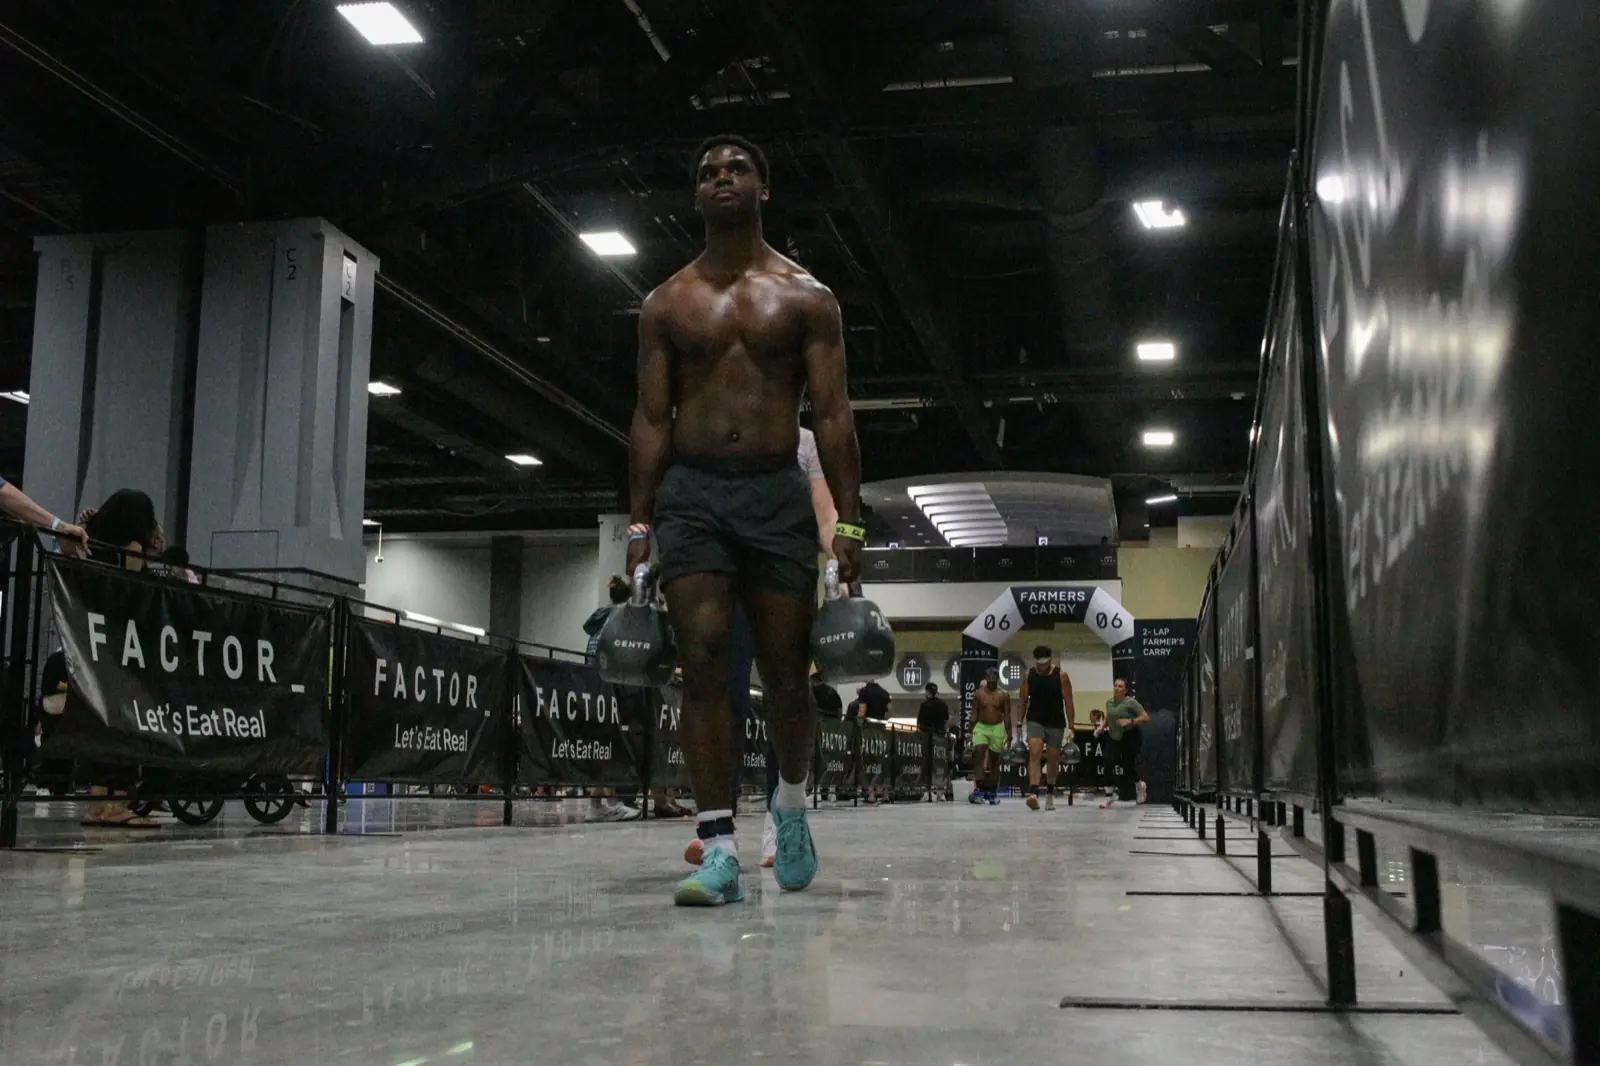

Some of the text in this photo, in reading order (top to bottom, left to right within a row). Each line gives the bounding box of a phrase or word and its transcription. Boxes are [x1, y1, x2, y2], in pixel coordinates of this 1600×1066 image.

[287, 265, 297, 280] 2
[1020, 591, 1086, 602] FARMERS
[1030, 604, 1076, 615] CARRY
[984, 614, 1010, 631] 06
[1096, 612, 1123, 629] 06
[820, 632, 856, 644] CENTR
[1143, 638, 1185, 646] FARMER'S
[614, 639, 651, 651] CENTR
[1143, 648, 1171, 656] CARRY
[133, 699, 266, 738] Let's Eat Real
[394, 723, 468, 752] Let's Eat Real
[552, 738, 612, 761] Let's Eat Real
